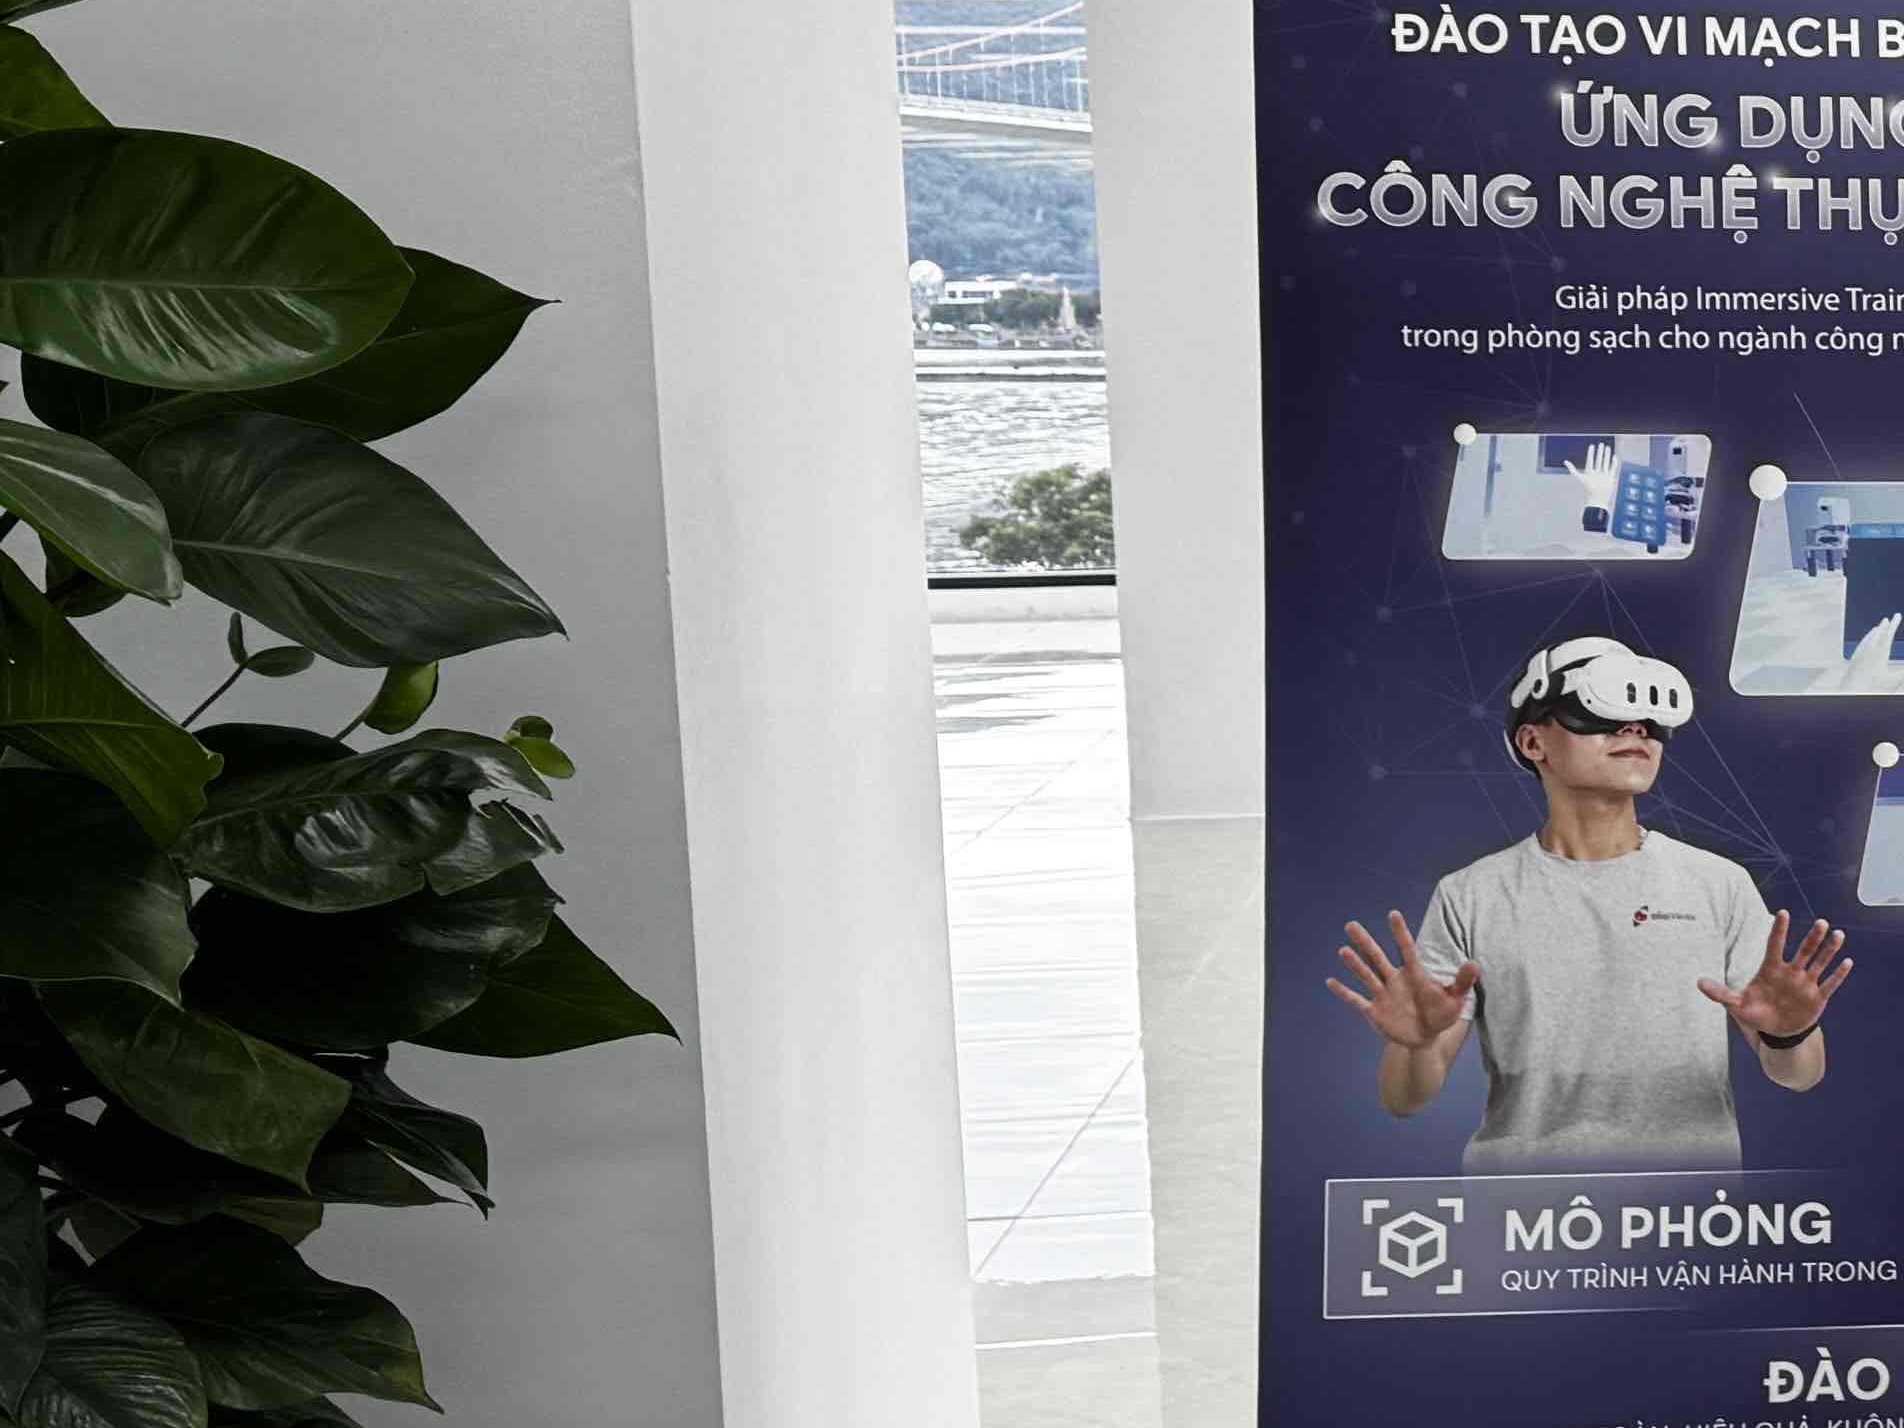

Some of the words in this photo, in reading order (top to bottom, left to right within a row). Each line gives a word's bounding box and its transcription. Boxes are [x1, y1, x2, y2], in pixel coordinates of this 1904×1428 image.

[1392, 2, 1508, 54] ĐÀO
[1519, 13, 1627, 67] TẠO
[1638, 15, 1689, 58] VI
[1704, 16, 1860, 68] MẠCH
[1559, 80, 1719, 150] ỨNG
[1315, 160, 1538, 229] CÔNG
[1560, 164, 1759, 245] NGHỆ
[1553, 285, 1608, 310] Giải
[1617, 285, 1689, 314] pháp
[1696, 287, 1840, 312] Immersive
[1401, 325, 1481, 355] trong
[1488, 322, 1581, 355] phòng
[1588, 323, 1652, 354] sạch
[1658, 326, 1708, 349] cho
[1719, 326, 1804, 355] ngành
[1815, 326, 1884, 356] công
[1503, 1195, 1604, 1253] MÔ
[1620, 1189, 1833, 1250] PHỎNG
[1501, 1269, 1561, 1294] QUY
[1567, 1257, 1648, 1291] TRÌNH
[1656, 1257, 1711, 1293] VẬN
[1718, 1252, 1796, 1285] HÀNH
[1803, 1259, 1898, 1285] TRONG
[1763, 1346, 1891, 1404] ĐÀO
